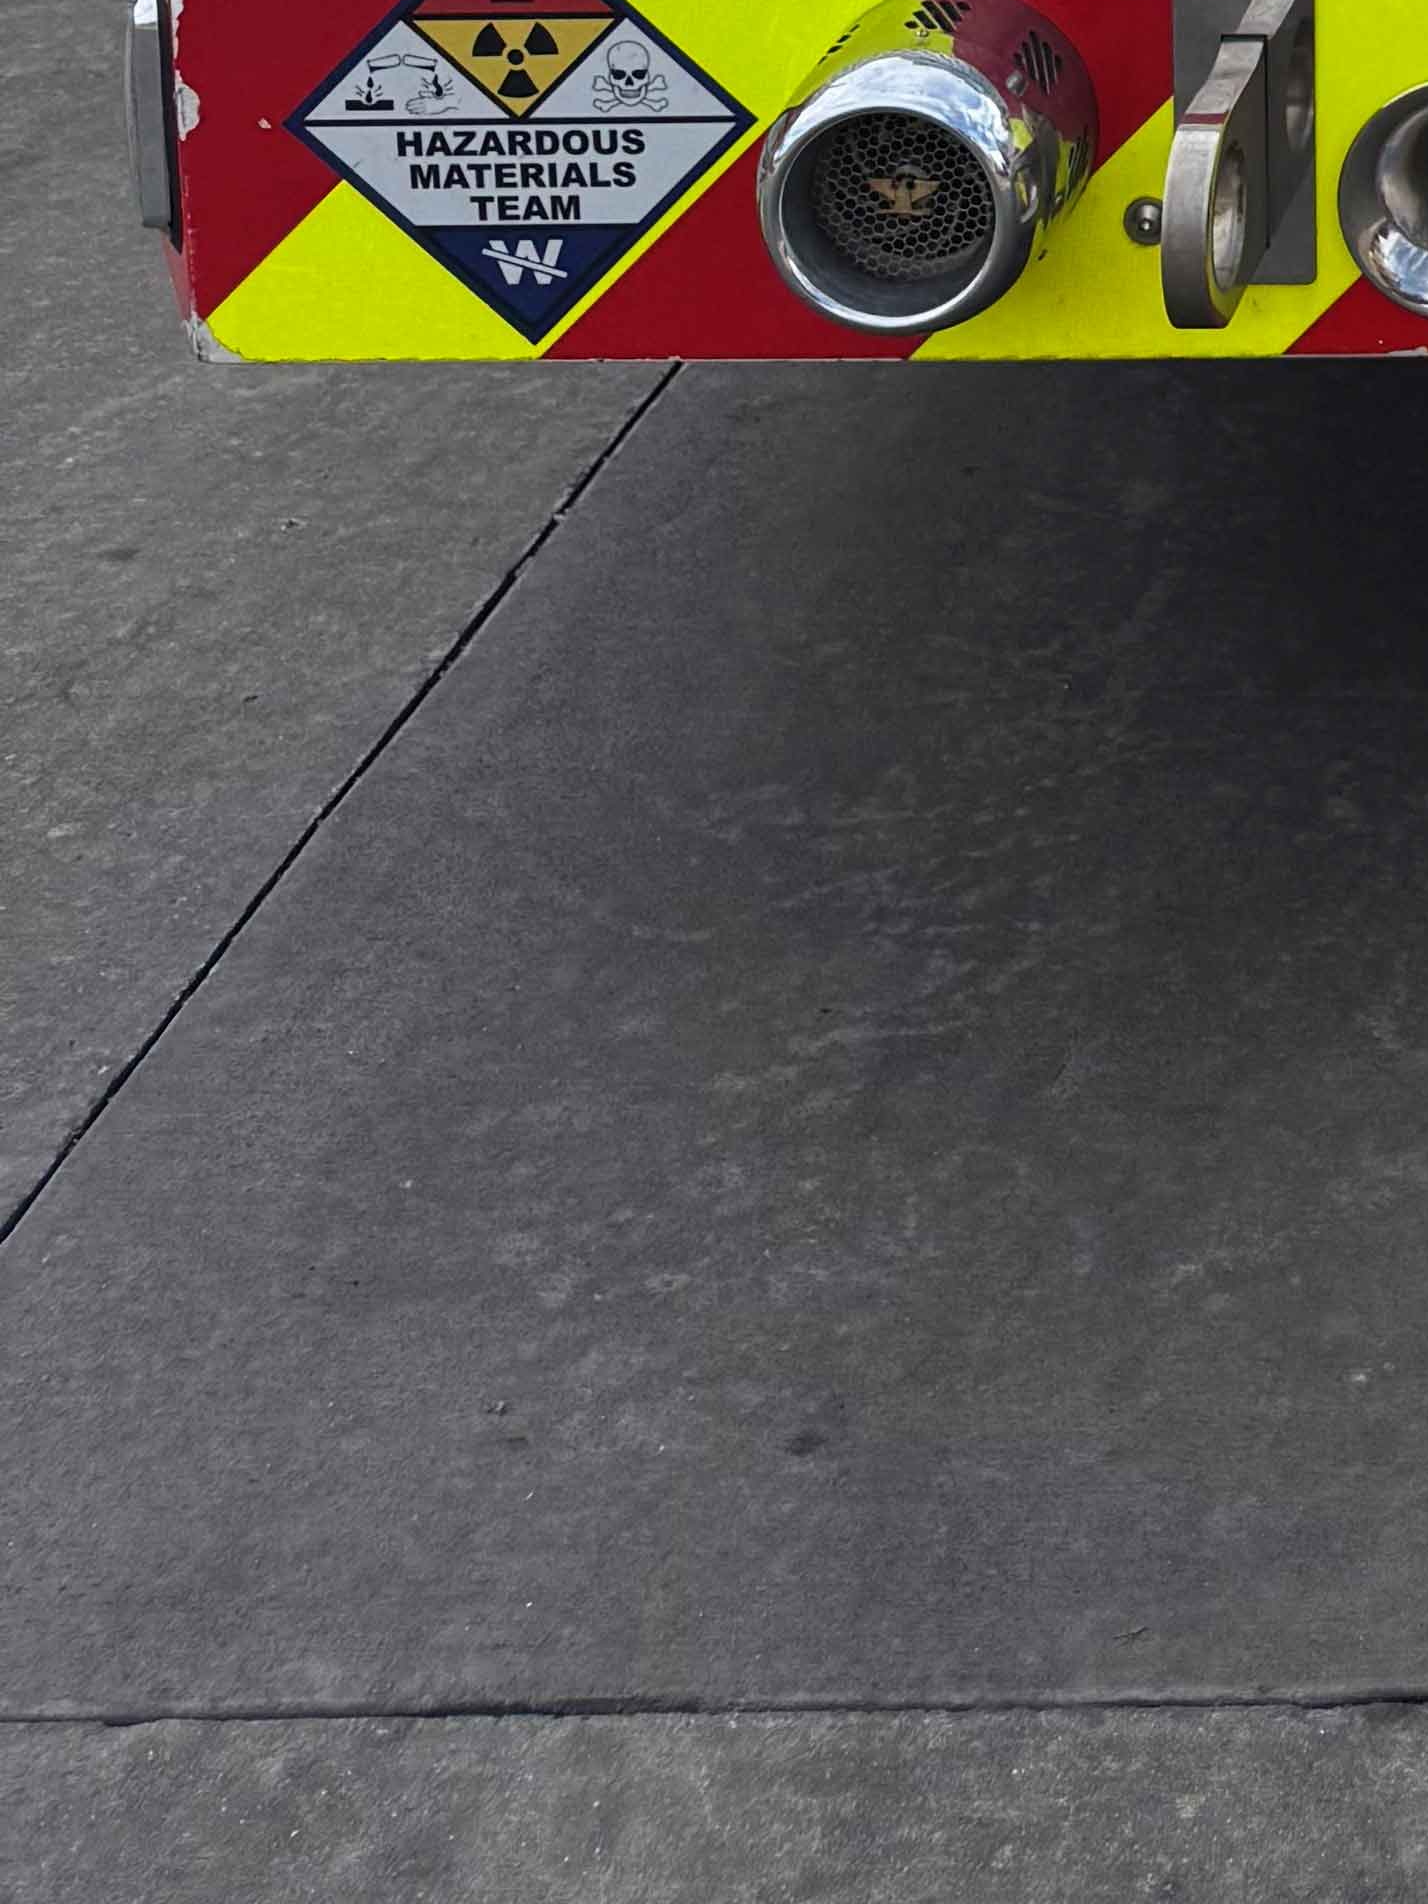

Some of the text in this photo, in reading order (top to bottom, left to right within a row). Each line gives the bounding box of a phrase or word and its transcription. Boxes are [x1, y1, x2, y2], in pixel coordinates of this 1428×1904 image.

[396, 128, 645, 157] HAZARDOUS
[409, 161, 637, 190] MATERIALS
[469, 194, 582, 221] TEAM
